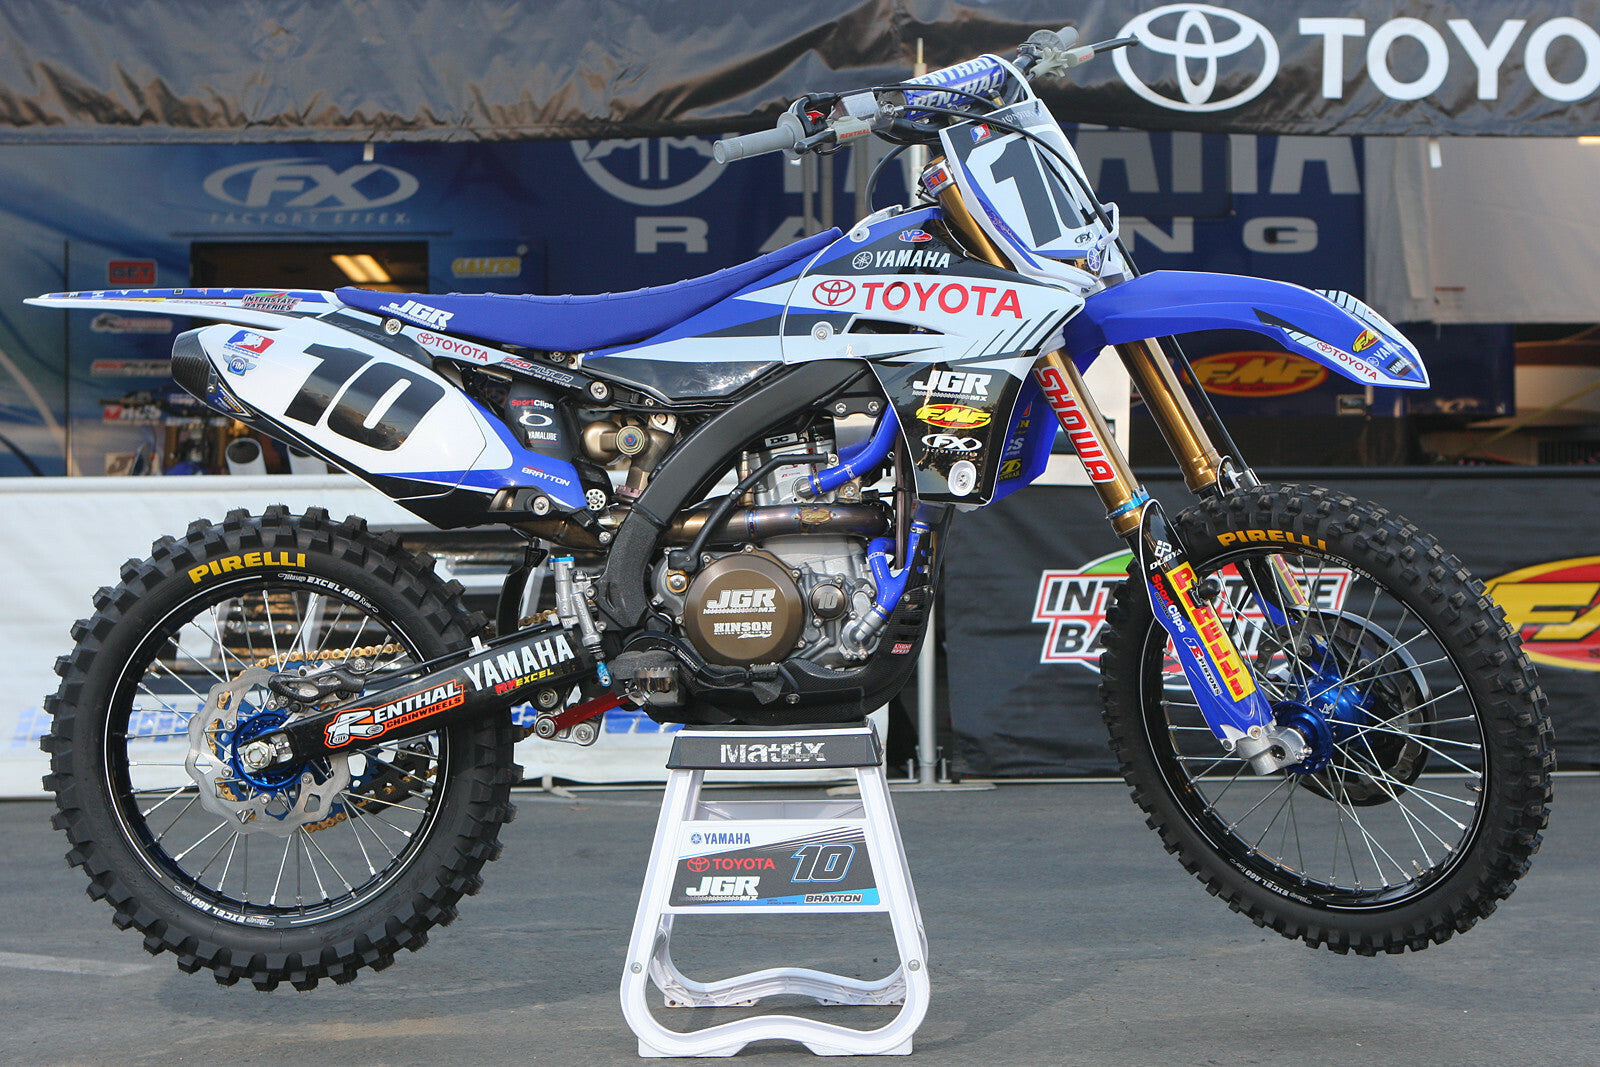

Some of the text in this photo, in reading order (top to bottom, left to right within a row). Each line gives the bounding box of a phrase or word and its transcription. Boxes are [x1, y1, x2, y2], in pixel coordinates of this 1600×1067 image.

[875, 250, 951, 269] YAMAHA
[244, 302, 292, 311] BATTERIES
[245, 295, 300, 305] INTERSTATE
[862, 282, 1023, 319] TOYOTA
[389, 300, 454, 328] JGR
[435, 337, 489, 362] TOYOTA
[503, 357, 575, 383] PROFILTER
[1190, 357, 1323, 386] FMF
[1332, 348, 1377, 381] TOYOTA
[913, 370, 993, 396] JGR
[283, 343, 446, 451] 10
[511, 400, 554, 409] SportClips
[916, 407, 992, 424] FMF
[1034, 366, 1115, 483] SHOWA
[527, 431, 558, 441] YAMALUBE
[929, 435, 974, 450] FX
[521, 467, 571, 486] BRAYTON
[1217, 530, 1327, 550] PIRELLI
[188, 552, 306, 585] PIRELLI
[1150, 548, 1182, 570] DUBYA
[306, 575, 341, 592] EXCEL
[706, 588, 776, 609] JGR
[817, 591, 839, 609] 10
[1151, 573, 1187, 633] SportClips
[713, 621, 773, 632] HINSON
[1172, 566, 1244, 697] PIRELLI
[463, 634, 575, 692] YAMAHA
[386, 697, 462, 728] CHAINWHEELS
[704, 833, 751, 845] YAMAHA
[712, 858, 776, 870] TOYOTA
[791, 843, 856, 883] 10
[686, 876, 760, 896] JGR
[805, 893, 863, 904] BRAYTON
[213, 906, 248, 924] EXCEL
